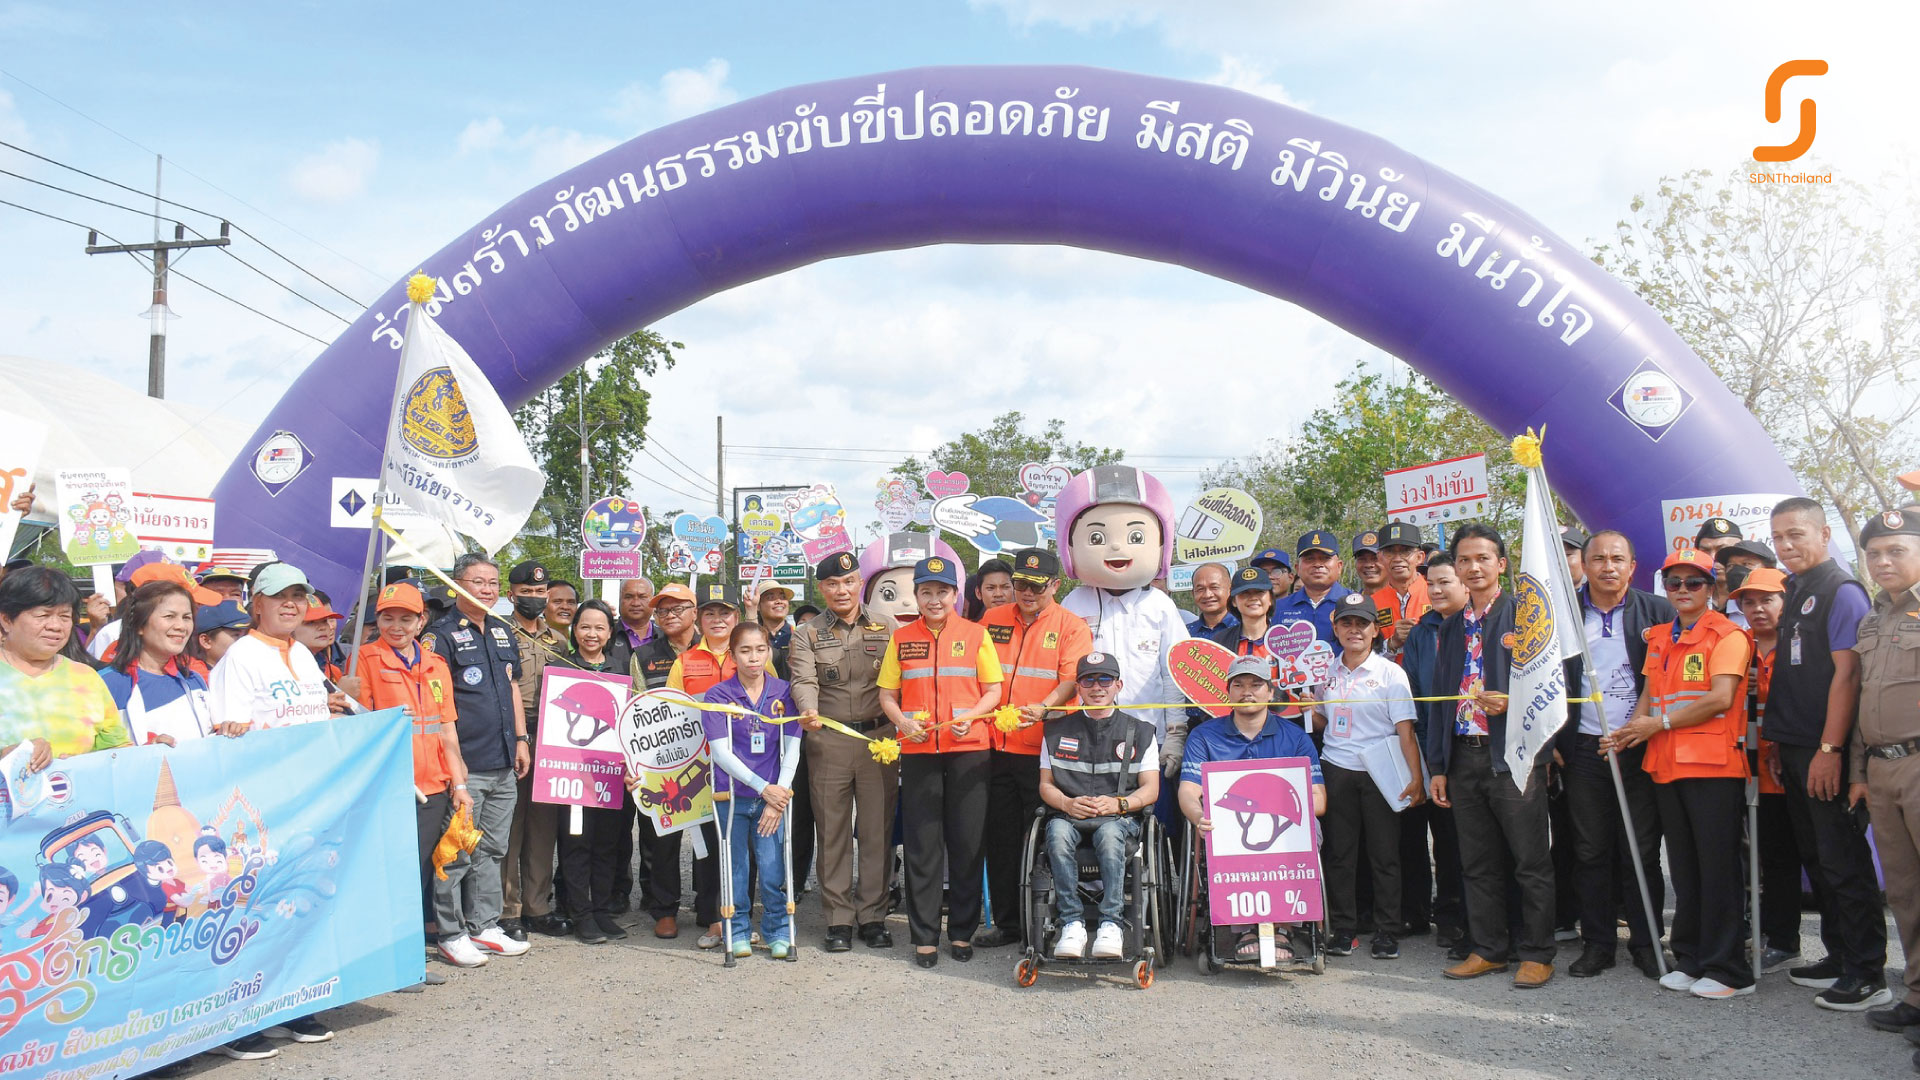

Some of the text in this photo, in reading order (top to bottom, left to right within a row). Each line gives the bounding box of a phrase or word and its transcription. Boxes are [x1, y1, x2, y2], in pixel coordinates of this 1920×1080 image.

[1135, 101, 1254, 171] มีสติ
[1270, 136, 1421, 233] มีวินัย
[1436, 210, 1595, 347] มีน้ำใจ
[1029, 473, 1062, 482] เคารพ
[1400, 470, 1474, 505] ง่วงไม่ขับ
[1199, 491, 1257, 532] ขับขี่ปลอดภัย
[1670, 501, 1723, 522] ถนน
[1184, 544, 1245, 560] ใส่ใจใส่หมวก
[270, 680, 301, 705] สุข
[633, 701, 685, 729] ตั้งสติ...
[630, 717, 703, 755] ก่อนสตาร์ท
[538, 757, 622, 776] สวมหมวกนิรภัย
[656, 747, 689, 766] ดื่มไม่ขับ
[548, 777, 611, 803] 100 %
[1213, 863, 1316, 884] สวมหมวกนิรภัย
[1226, 889, 1307, 917] 100 %
[64, 1010, 167, 1057] สังคมไทย
[173, 973, 263, 1024] เคารพสิทธิ์
